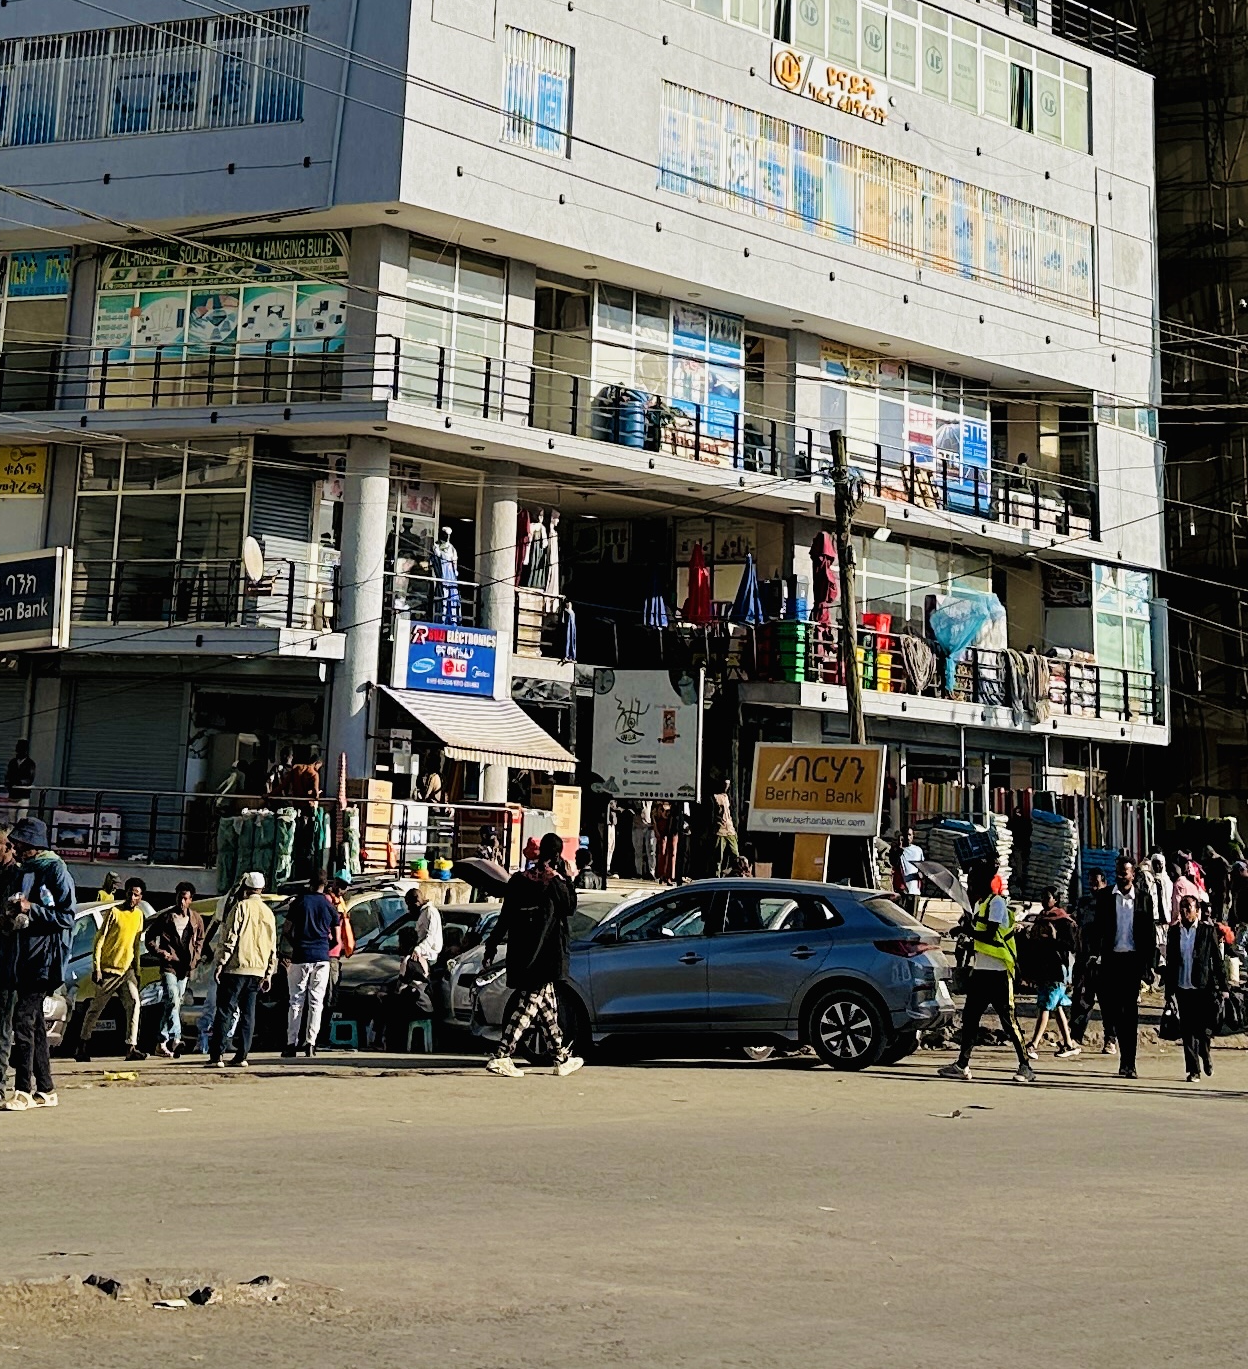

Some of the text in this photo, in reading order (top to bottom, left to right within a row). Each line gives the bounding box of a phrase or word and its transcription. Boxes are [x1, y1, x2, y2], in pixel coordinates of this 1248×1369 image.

[179, 244, 210, 264] SOLAR
[262, 240, 307, 260] HANGING
[307, 237, 333, 257] BULB
[5, 573, 37, 597] ባንክ
[17, 597, 49, 620] Bank
[765, 786, 863, 804] Berhan Bank
